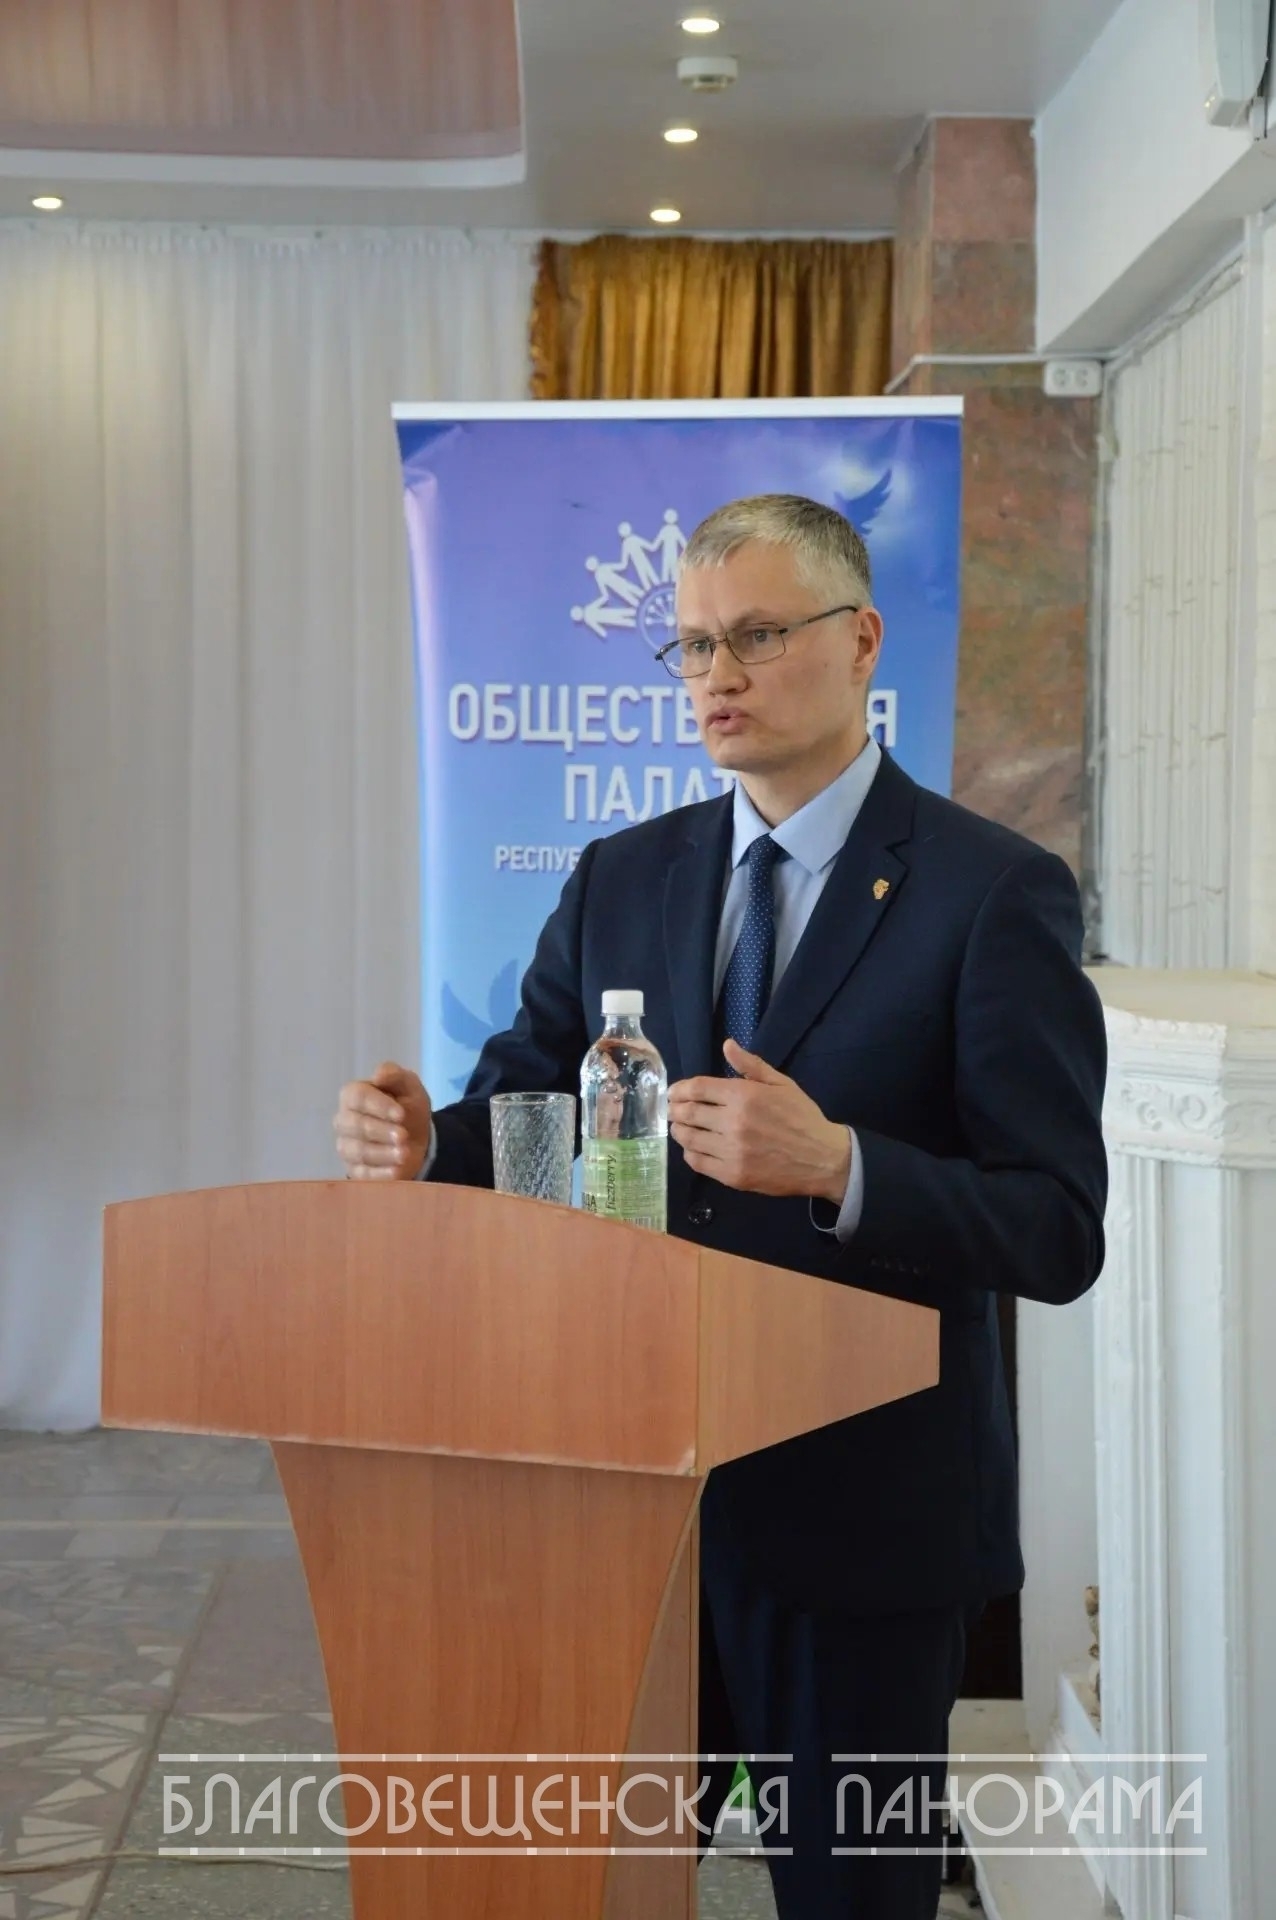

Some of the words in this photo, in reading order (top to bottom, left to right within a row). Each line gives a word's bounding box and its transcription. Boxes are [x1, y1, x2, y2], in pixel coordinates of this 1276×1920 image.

[449, 683, 898, 754] ОБЩЕСТВЯ
[564, 764, 738, 823] ПАЛАТ
[494, 845, 581, 872] РЕСПУБ
